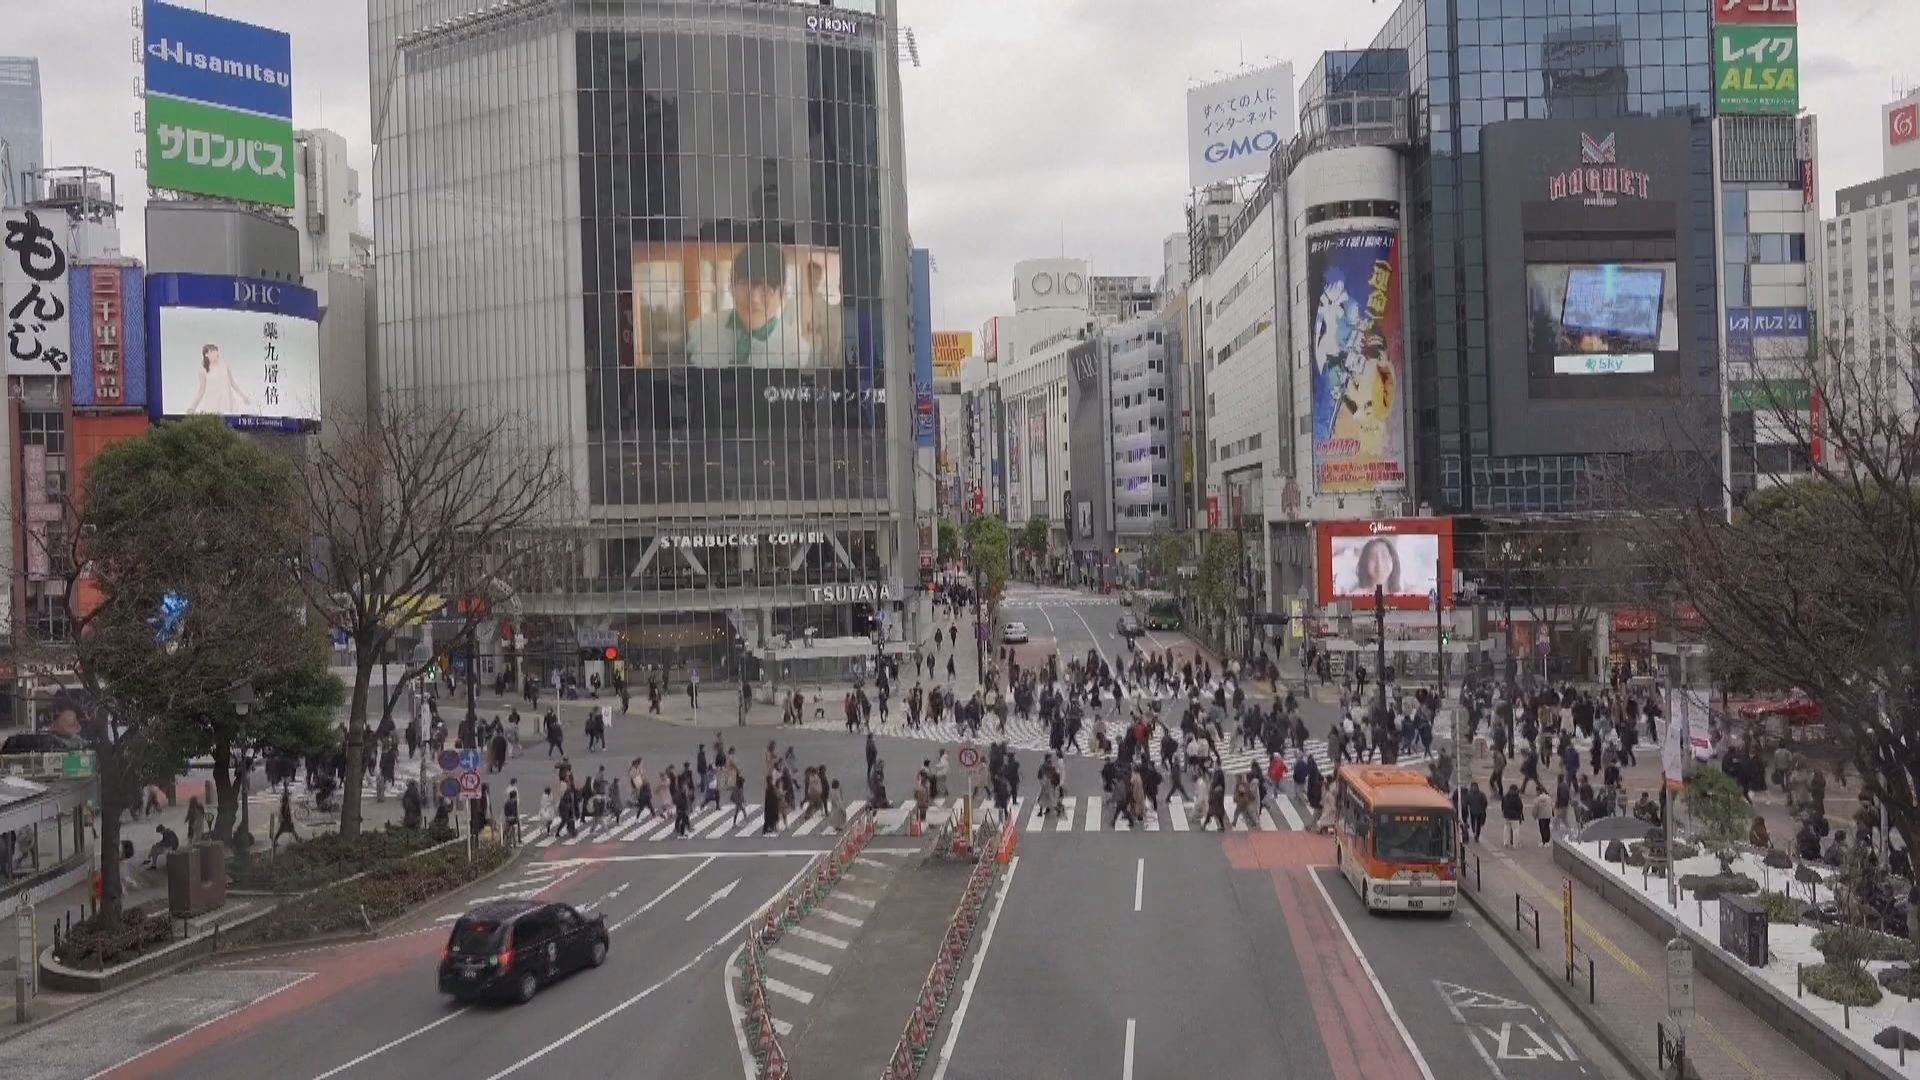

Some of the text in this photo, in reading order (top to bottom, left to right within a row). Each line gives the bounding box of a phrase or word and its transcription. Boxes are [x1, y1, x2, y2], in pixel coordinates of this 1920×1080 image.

[148, 38, 289, 87] Hisamitsu
[1722, 35, 1793, 63] レイク
[1721, 67, 1795, 90] ALSA
[1204, 88, 1277, 119] すべての人に
[1203, 106, 1278, 136] インターネット
[156, 123, 286, 179] サロンパス
[1204, 130, 1279, 163] GMO
[5, 209, 68, 373] もんじゃ
[233, 281, 281, 305] DHC
[660, 533, 758, 550] STARBUCKS
[811, 583, 890, 603] TSUTAYA
